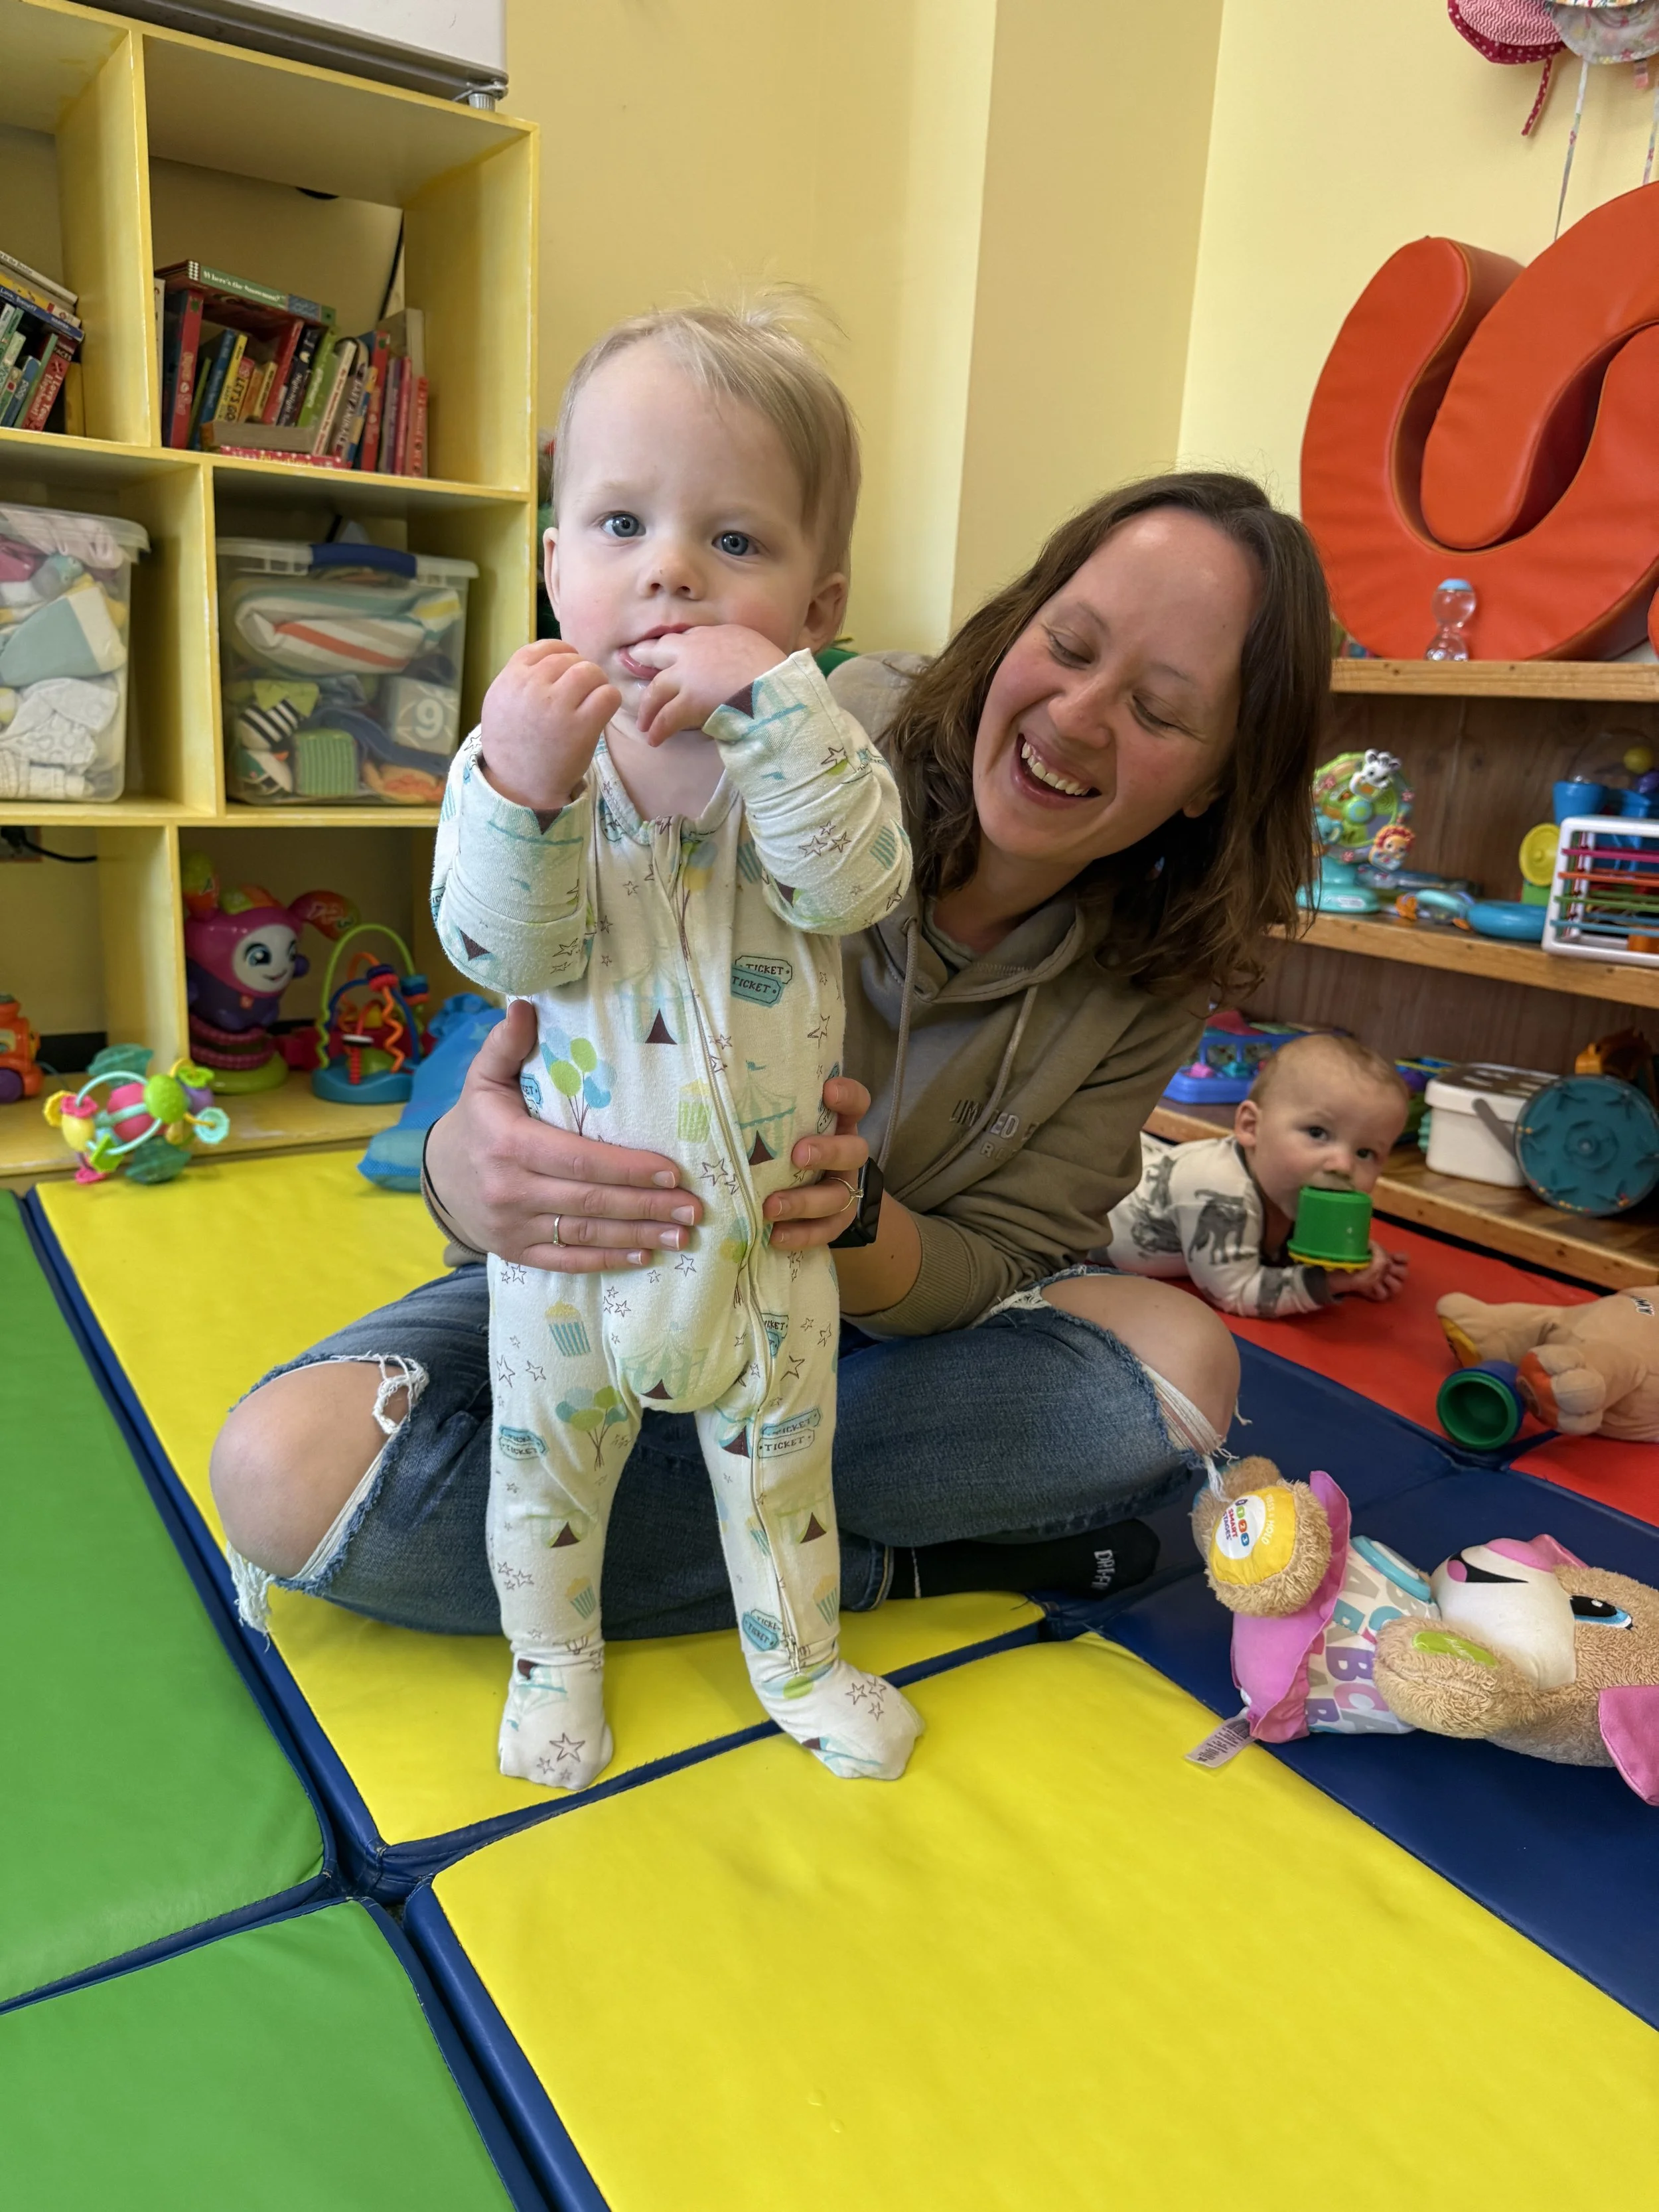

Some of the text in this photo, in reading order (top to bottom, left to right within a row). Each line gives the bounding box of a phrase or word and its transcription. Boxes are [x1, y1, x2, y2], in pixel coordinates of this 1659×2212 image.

[415, 699, 445, 740] 9
[746, 964, 784, 975] TICKET
[732, 976, 771, 993] TICKET
[773, 1417, 811, 1435] TICKET
[764, 1436, 804, 1451] TICKET
[1228, 1508, 1238, 1538] SMART
[1261, 1520, 1275, 1546] HOLD
[749, 1622, 770, 1643] TICKET
